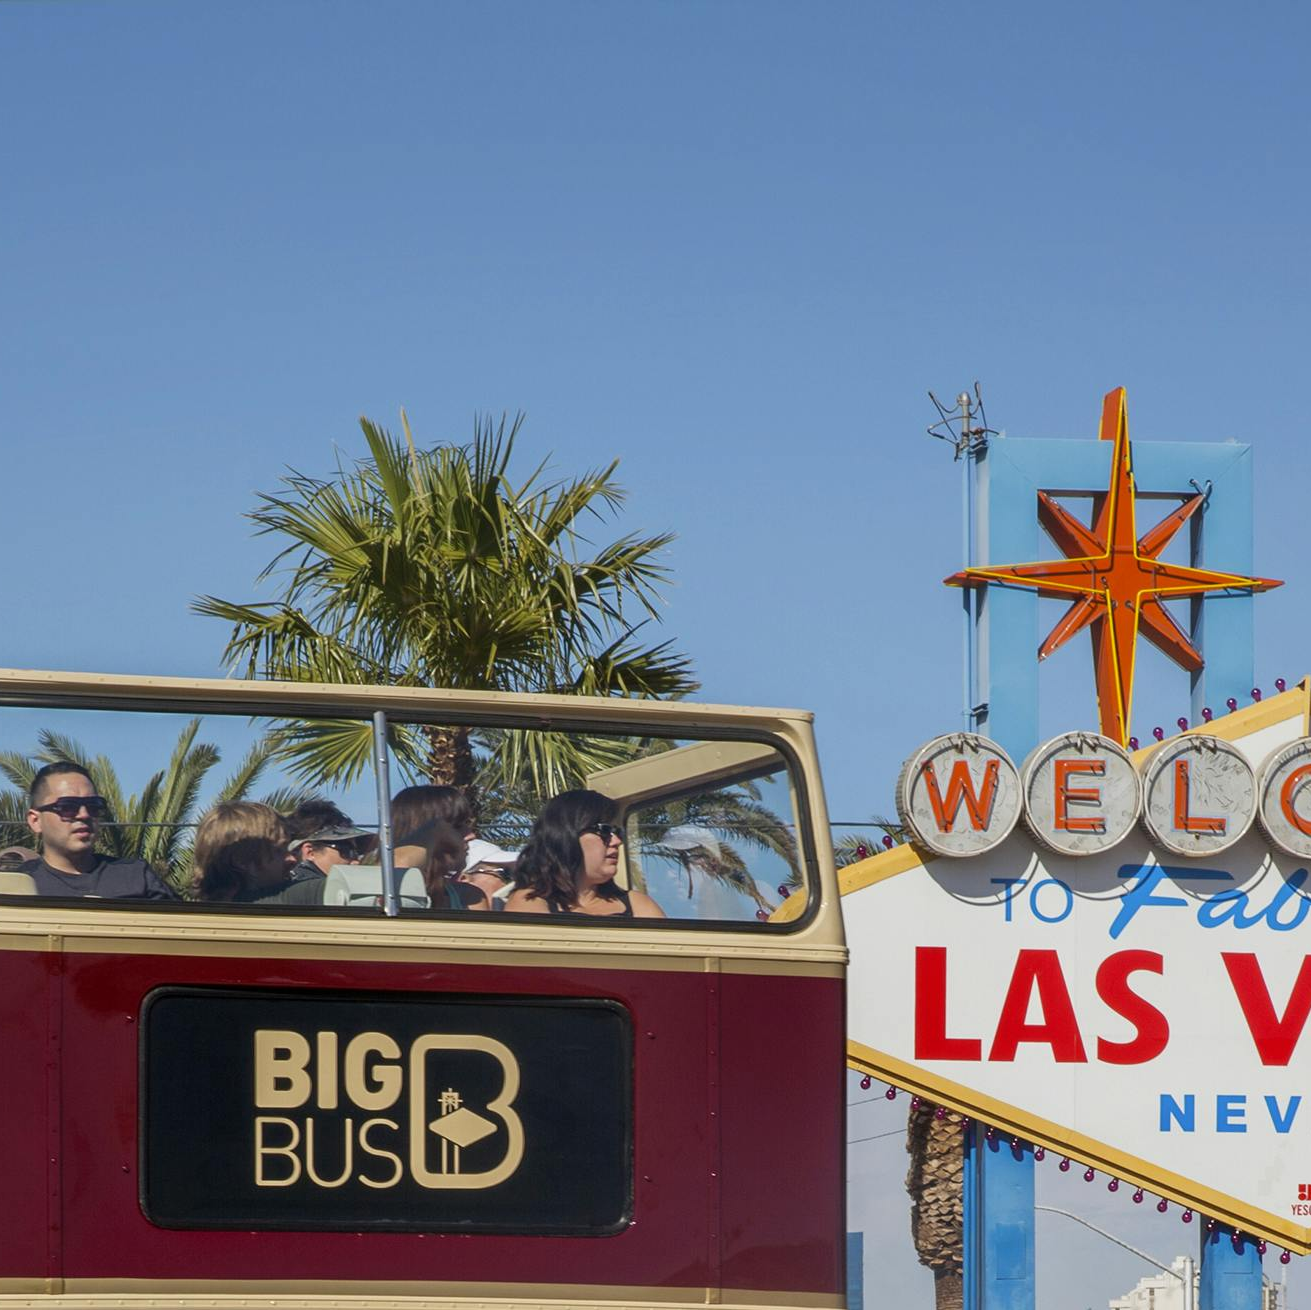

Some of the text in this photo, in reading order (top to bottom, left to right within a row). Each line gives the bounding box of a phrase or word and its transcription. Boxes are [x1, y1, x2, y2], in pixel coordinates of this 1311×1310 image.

[990, 876, 1075, 925] TO
[913, 945, 1171, 1066] LAS
[254, 1029, 403, 1111] BIG
[254, 1116, 404, 1188] BUS
